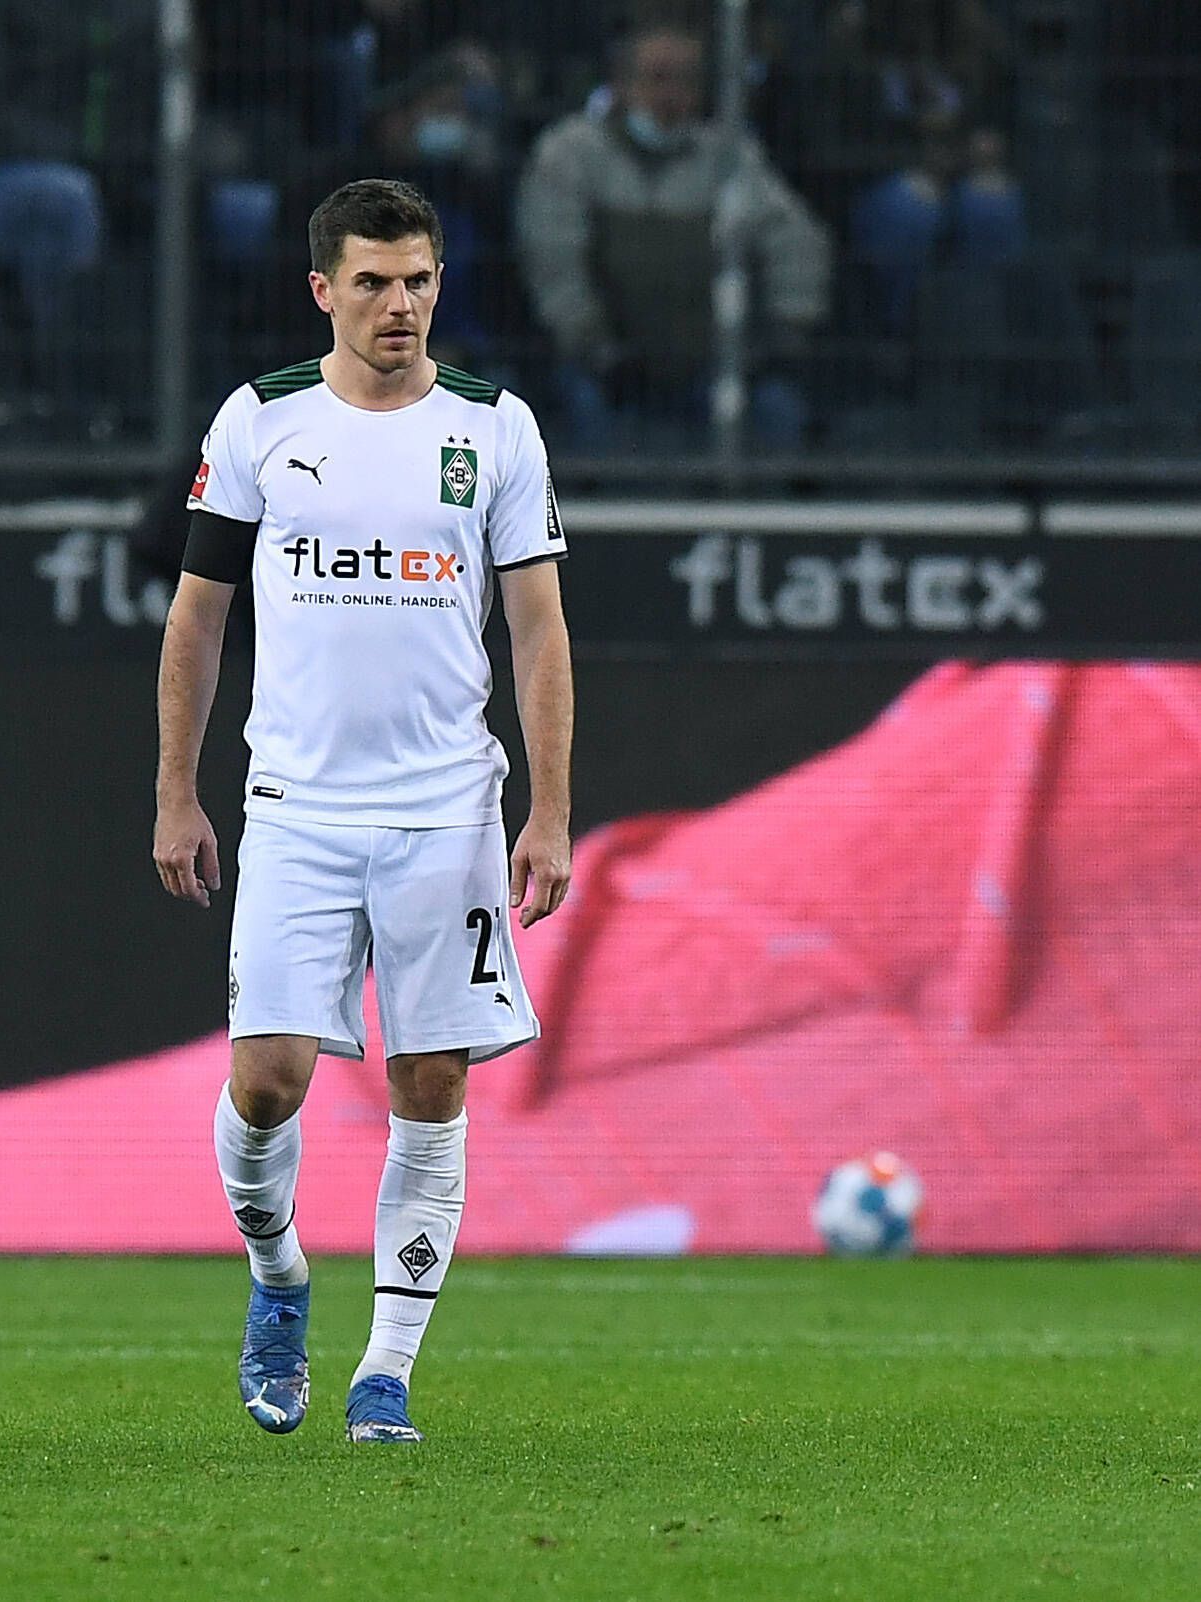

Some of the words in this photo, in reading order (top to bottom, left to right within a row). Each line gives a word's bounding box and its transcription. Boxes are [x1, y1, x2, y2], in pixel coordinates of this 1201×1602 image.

[291, 592, 339, 605] AKTIEN.
[341, 594, 397, 607] ONLINE.
[400, 596, 461, 609] HANDELN.
[466, 907, 506, 985] 2
